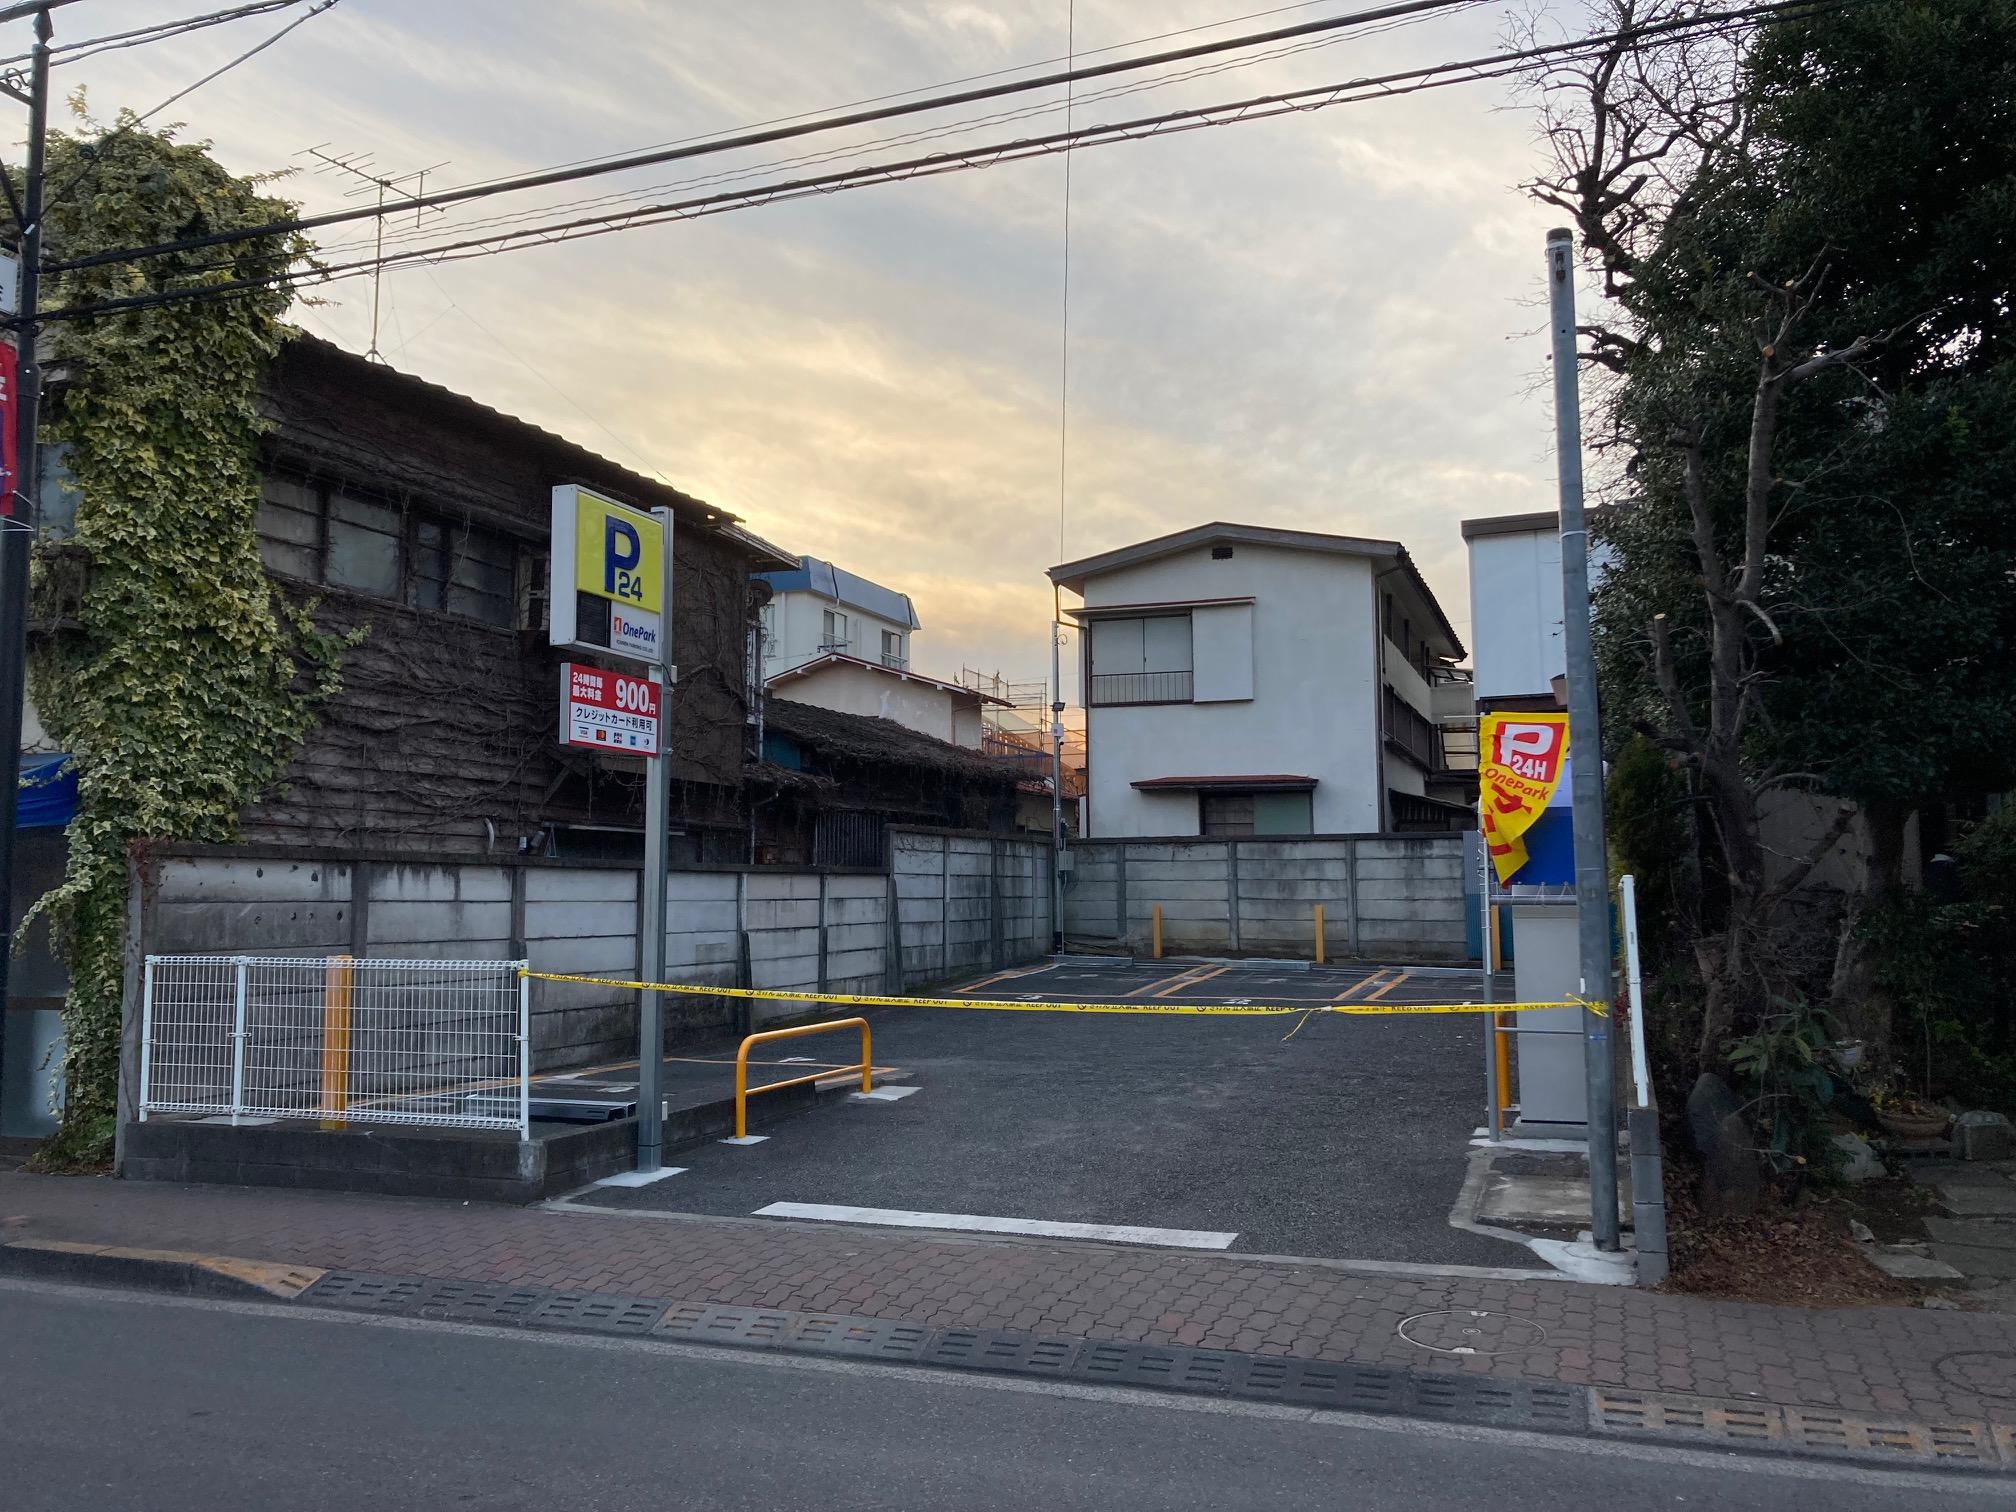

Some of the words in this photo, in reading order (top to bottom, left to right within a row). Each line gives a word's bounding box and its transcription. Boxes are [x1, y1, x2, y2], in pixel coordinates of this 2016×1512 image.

[604, 514, 641, 594] P
[618, 571, 643, 602] 24
[622, 622, 656, 643] OnePark
[576, 706, 653, 732] クレジットカード利用可
[1500, 723, 1554, 767] P
[1511, 754, 1547, 780] 24H
[1485, 768, 1550, 801] OnePark
